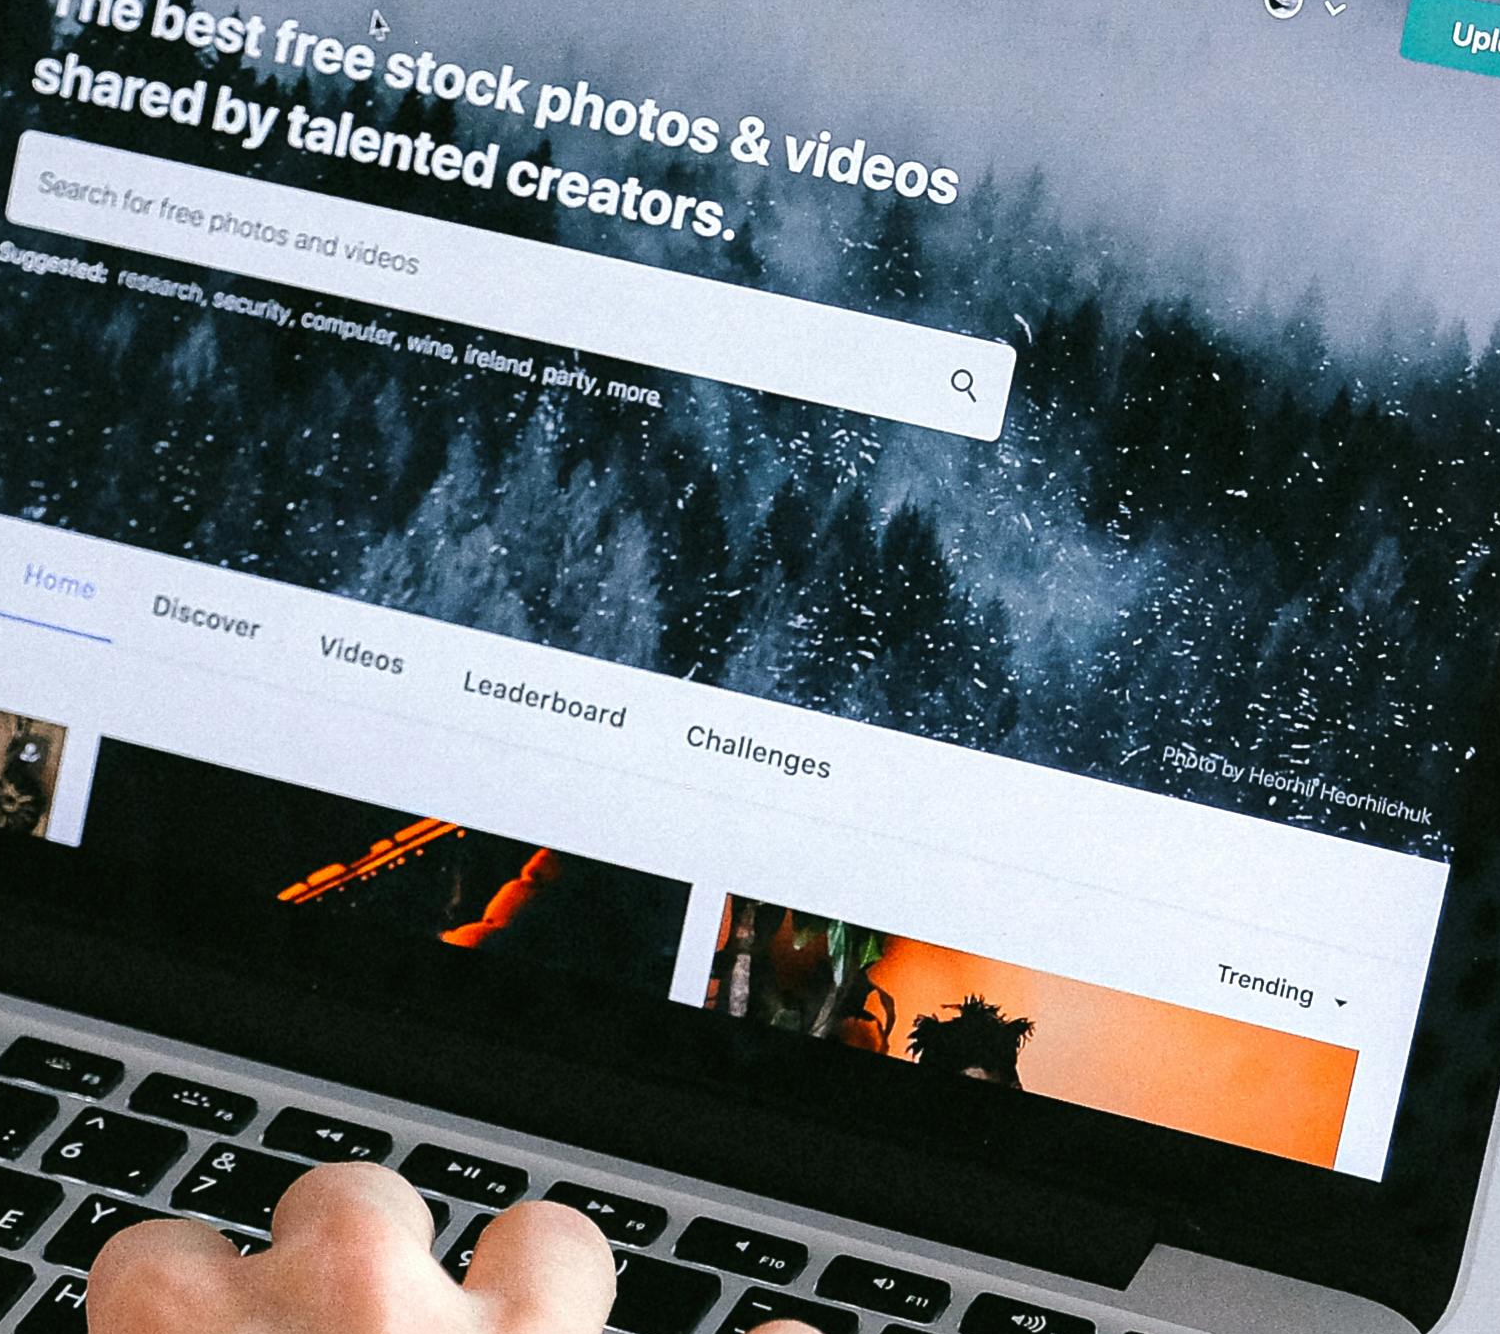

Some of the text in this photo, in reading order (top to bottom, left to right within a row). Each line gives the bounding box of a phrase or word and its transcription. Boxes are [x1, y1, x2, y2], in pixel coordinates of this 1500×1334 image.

[273, 19, 377, 82] free
[383, 50, 531, 116] stock
[533, 81, 721, 154] photos
[730, 115, 771, 166] &
[784, 129, 961, 206] videos
[32, 52, 736, 242] shared by talented creators.
[37, 170, 421, 276] Search for free photos and videos
[117, 270, 208, 308] research,
[211, 291, 297, 328] security,
[300, 310, 401, 351] computer,
[406, 333, 459, 365] wine,
[463, 343, 537, 383] ireland,
[542, 363, 602, 397] party,
[22, 562, 98, 601] Home
[151, 593, 263, 641] Discover
[318, 634, 406, 677] Videos
[462, 670, 628, 730] Leaderboard
[685, 723, 834, 781] Challenges
[1162, 745, 1217, 774] Photo
[1222, 758, 1245, 784] by
[1216, 963, 1315, 1010] Trending
[60, 1142, 84, 1157] 6
[211, 1152, 236, 1172] &
[191, 1176, 217, 1193] 7
[91, 1202, 117, 1224] Y
[625, 1220, 646, 1231] F9
[759, 1255, 785, 1269] F10
[905, 1295, 929, 1308] F11
